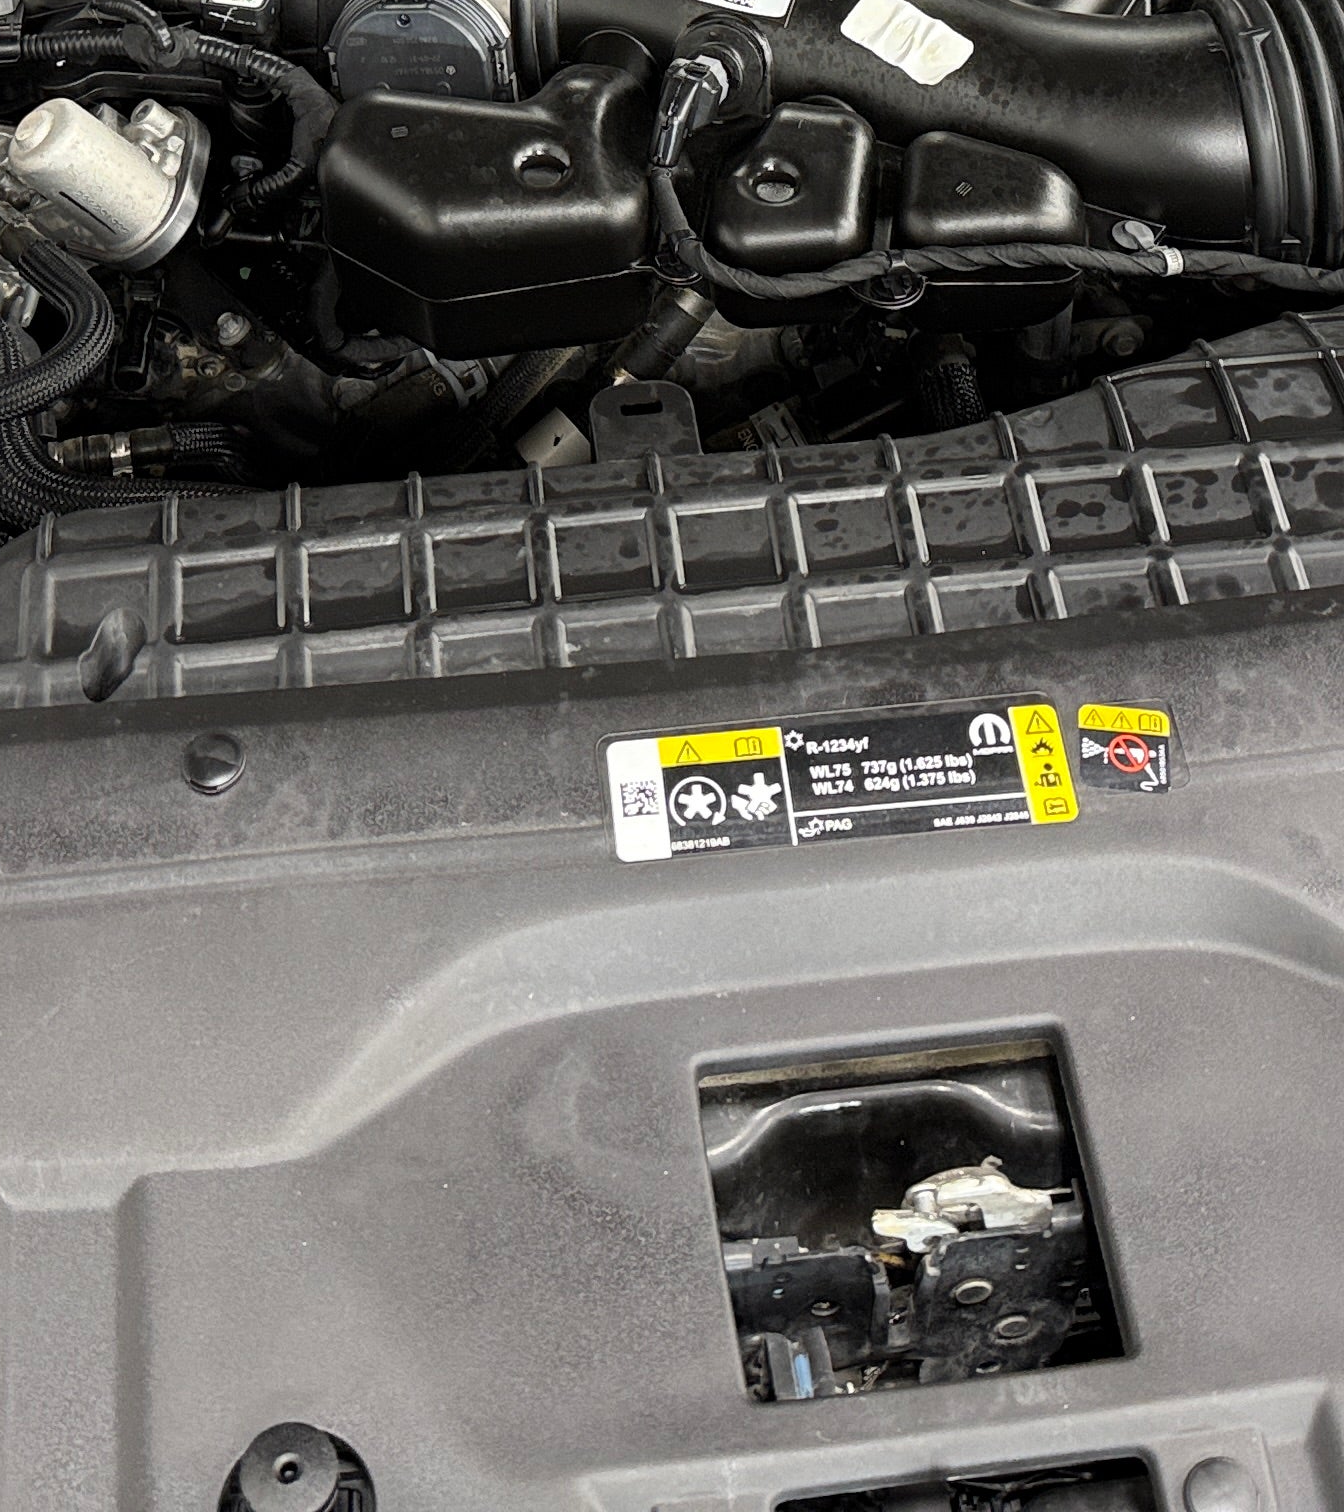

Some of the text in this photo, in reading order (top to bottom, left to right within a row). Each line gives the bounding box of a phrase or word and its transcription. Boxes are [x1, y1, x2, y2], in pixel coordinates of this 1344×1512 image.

[806, 736, 870, 756] R-1234yf
[809, 752, 974, 779] WL75 737g (1.625 lbs)
[812, 768, 977, 795] WL74 624g (1.375 lbs)
[824, 817, 853, 832] PAG
